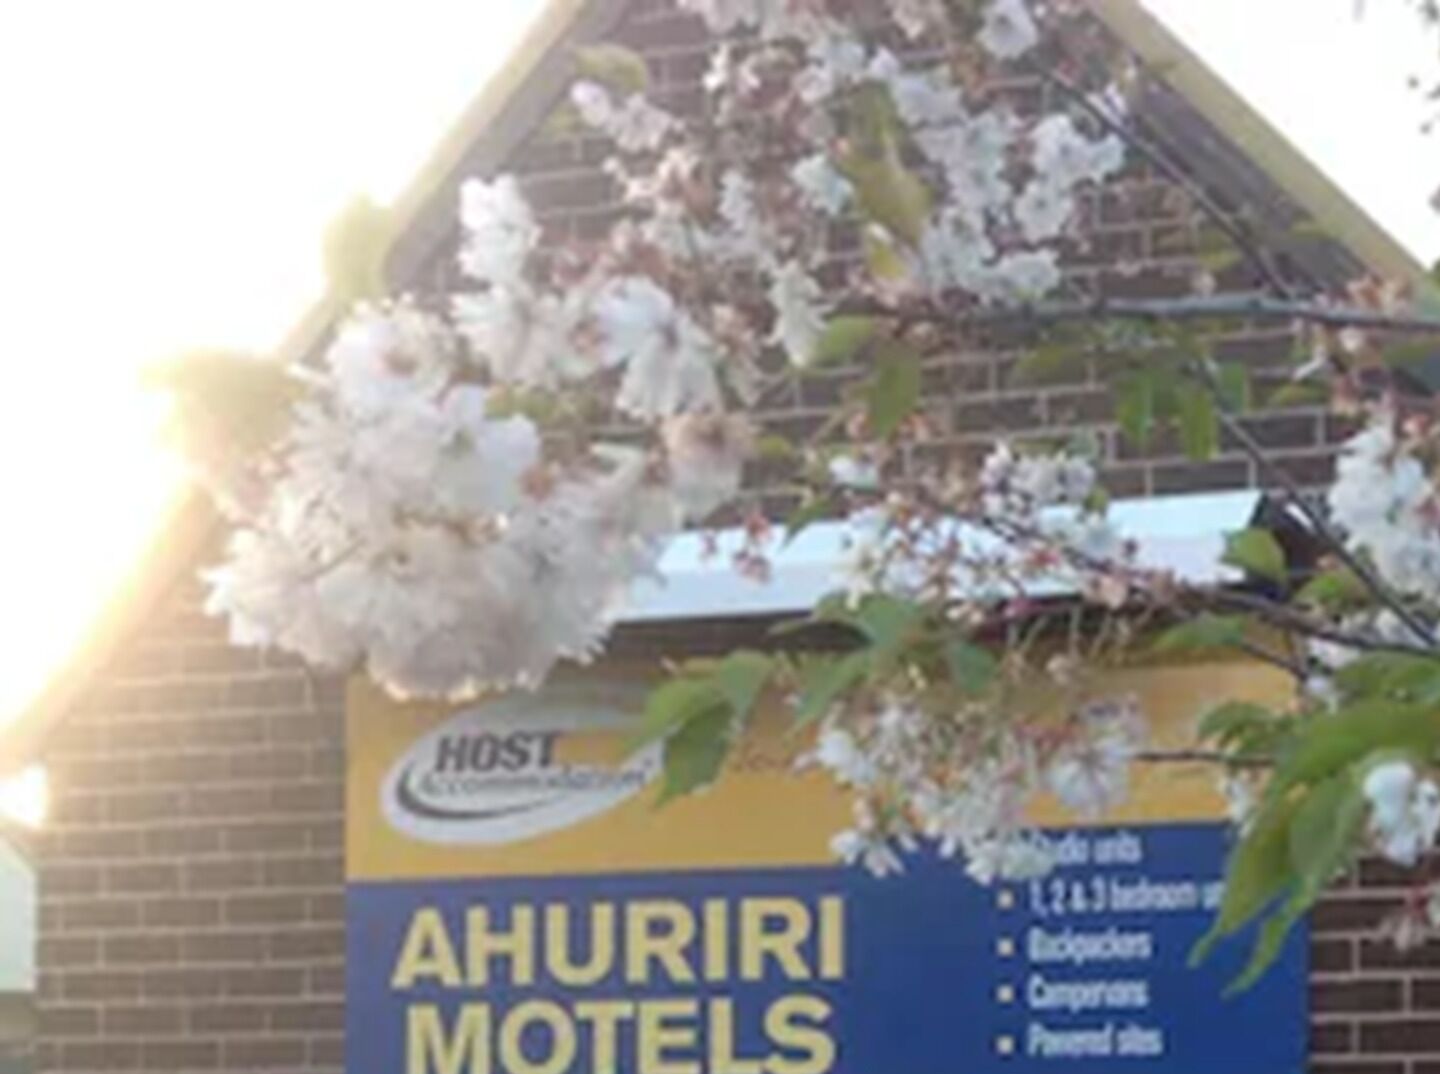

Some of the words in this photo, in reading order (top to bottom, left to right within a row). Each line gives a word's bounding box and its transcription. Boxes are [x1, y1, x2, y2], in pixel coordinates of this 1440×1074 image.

[435, 731, 557, 773] HOST
[1050, 878, 1066, 915] 2
[1091, 876, 1106, 913] 3
[1110, 876, 1197, 911] bedroom
[390, 896, 846, 989] AHURIRI
[1028, 926, 1153, 965] Backpackers
[1028, 1020, 1113, 1056] Powered
